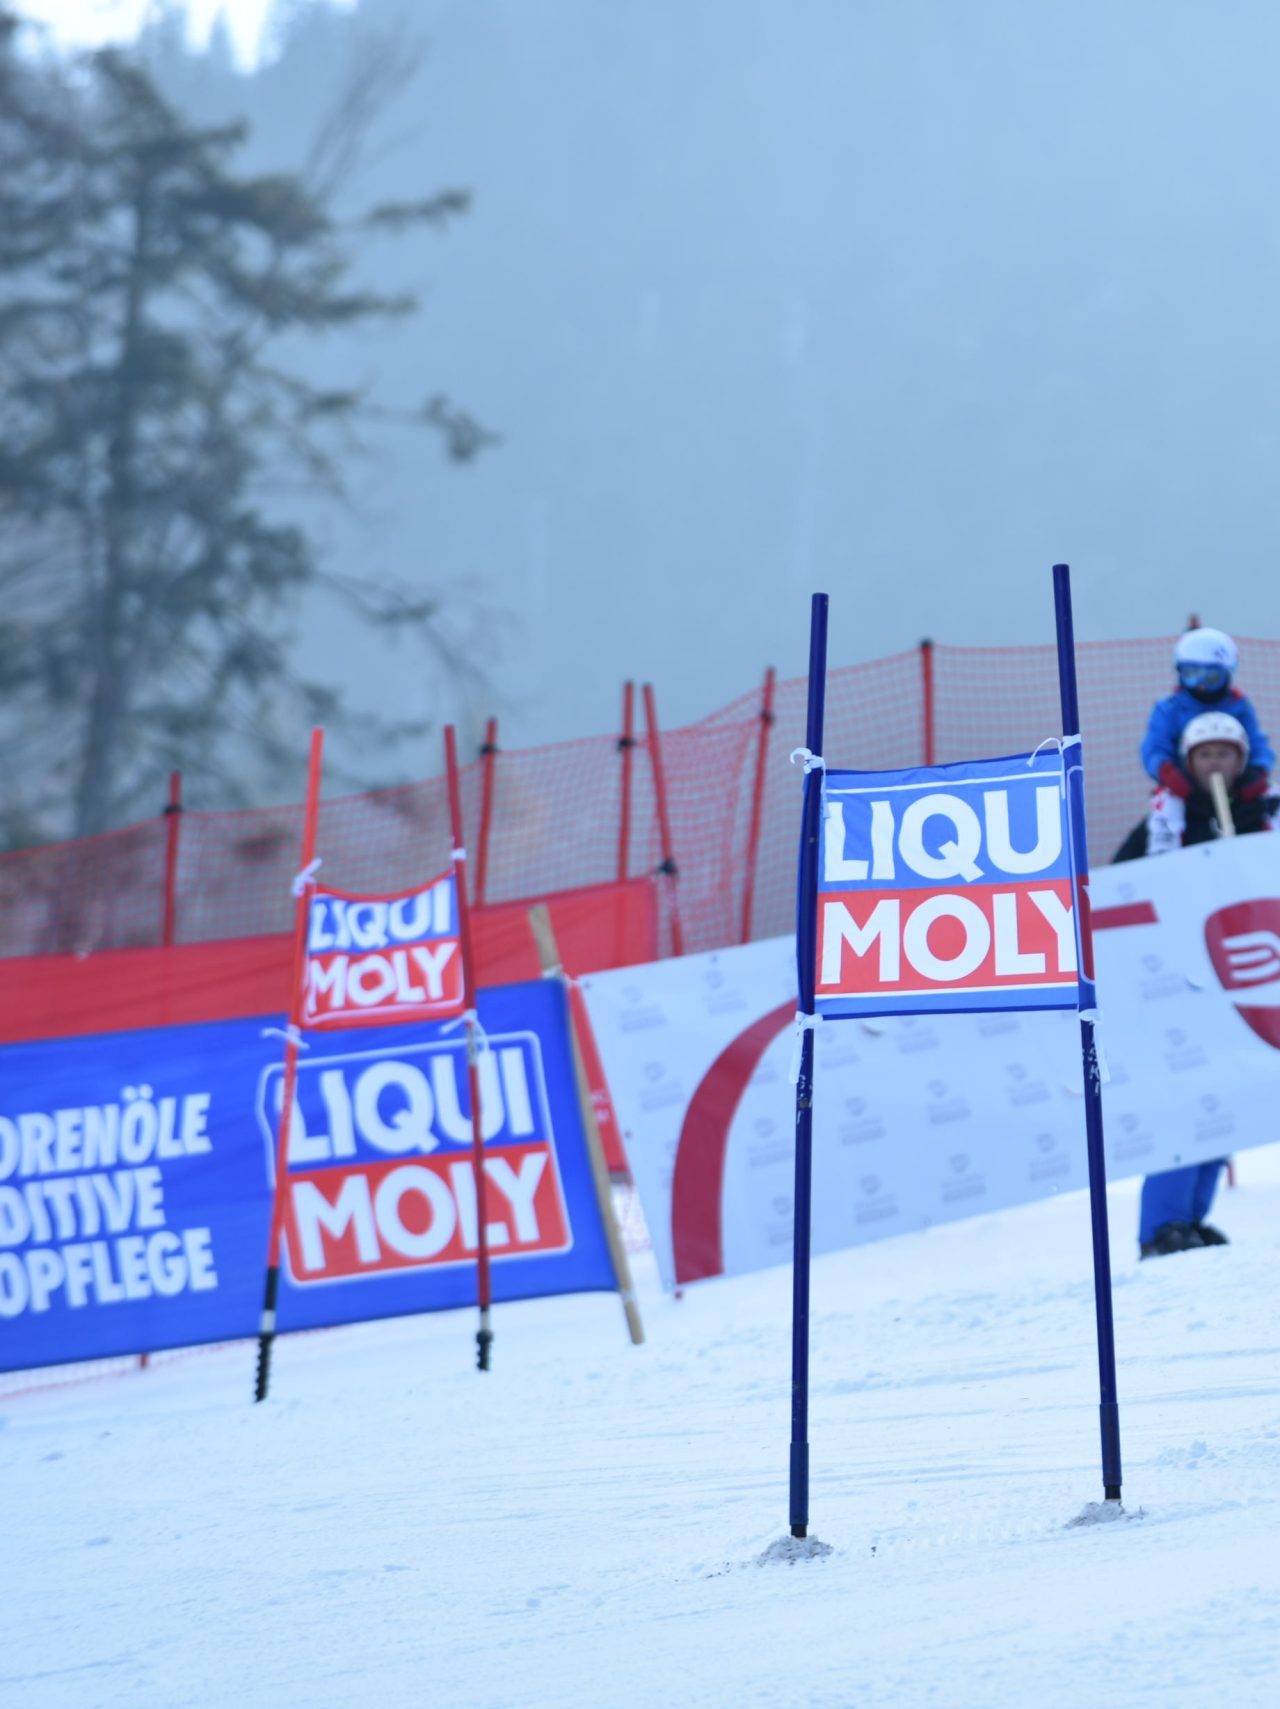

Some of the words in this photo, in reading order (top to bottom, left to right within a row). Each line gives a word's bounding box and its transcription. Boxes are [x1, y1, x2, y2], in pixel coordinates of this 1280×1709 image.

[823, 785, 1063, 883] LIQU
[309, 879, 452, 952] LIQUI
[819, 889, 1079, 985] MOLY
[307, 942, 458, 1014] MOLY
[274, 1047, 535, 1165] LIQUI
[291, 1152, 550, 1272] MOLY
